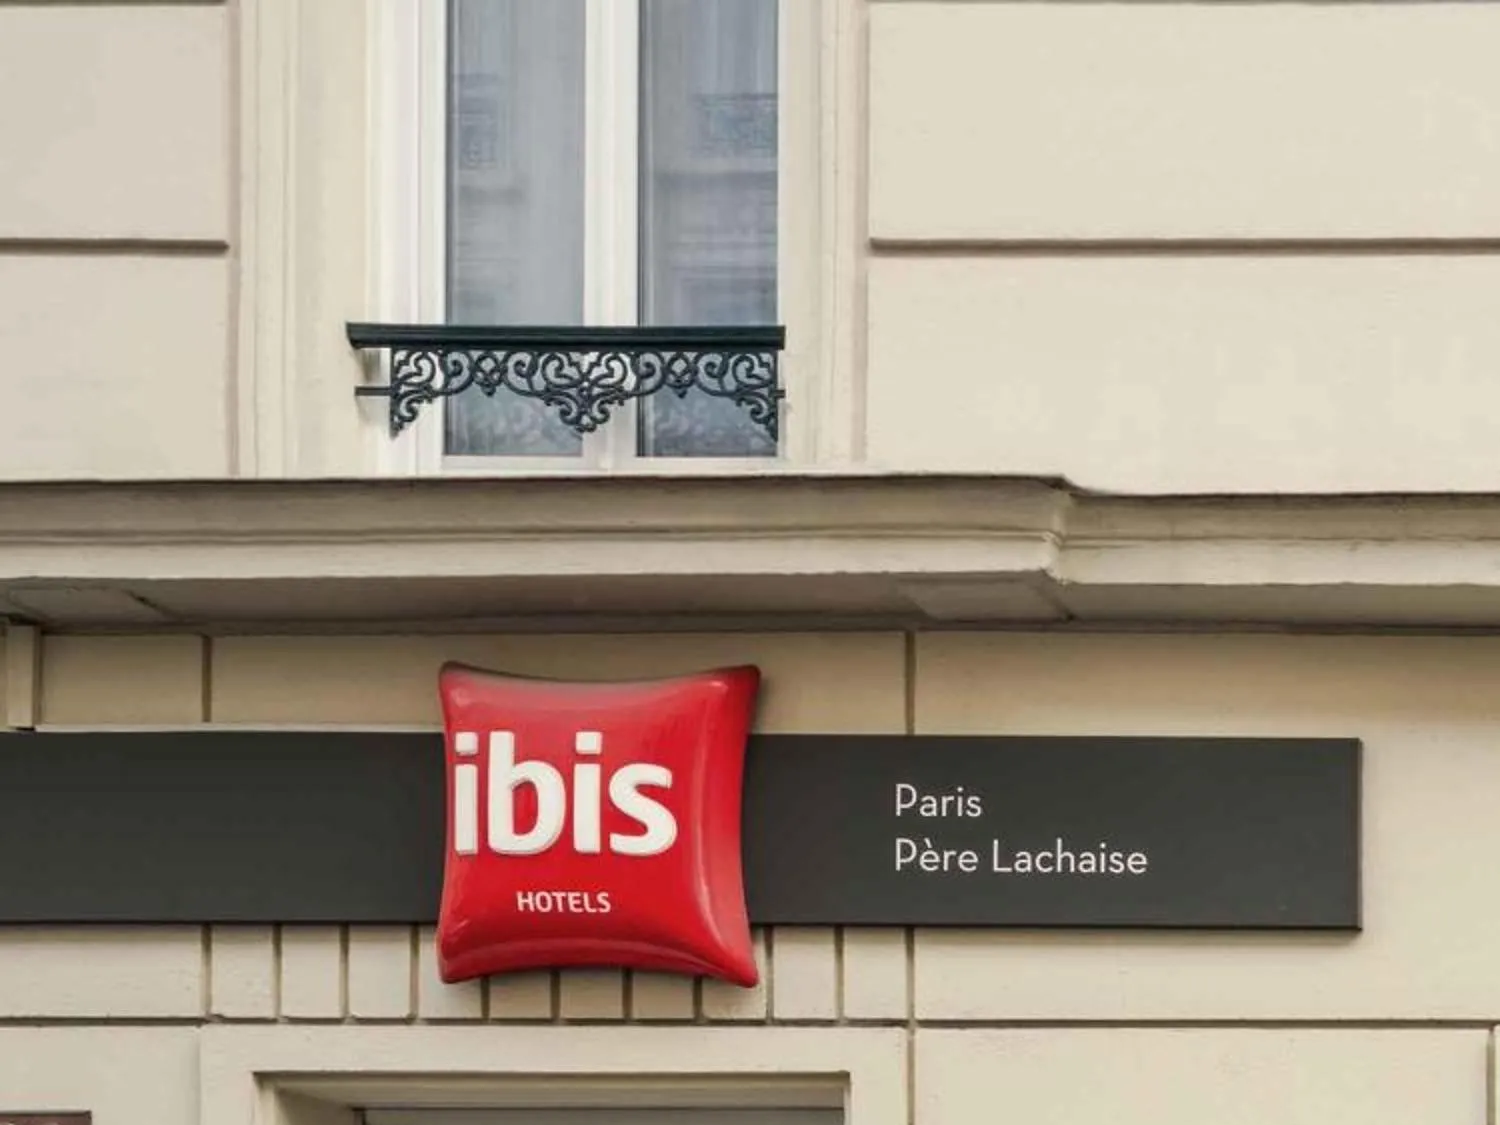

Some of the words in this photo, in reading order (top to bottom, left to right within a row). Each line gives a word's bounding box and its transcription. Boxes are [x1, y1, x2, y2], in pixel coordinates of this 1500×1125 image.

[453, 730, 678, 855] ibis
[894, 783, 983, 819] Paris
[894, 838, 980, 873] Père
[991, 838, 1149, 876] Lachaise
[516, 891, 612, 915] HOTELS
